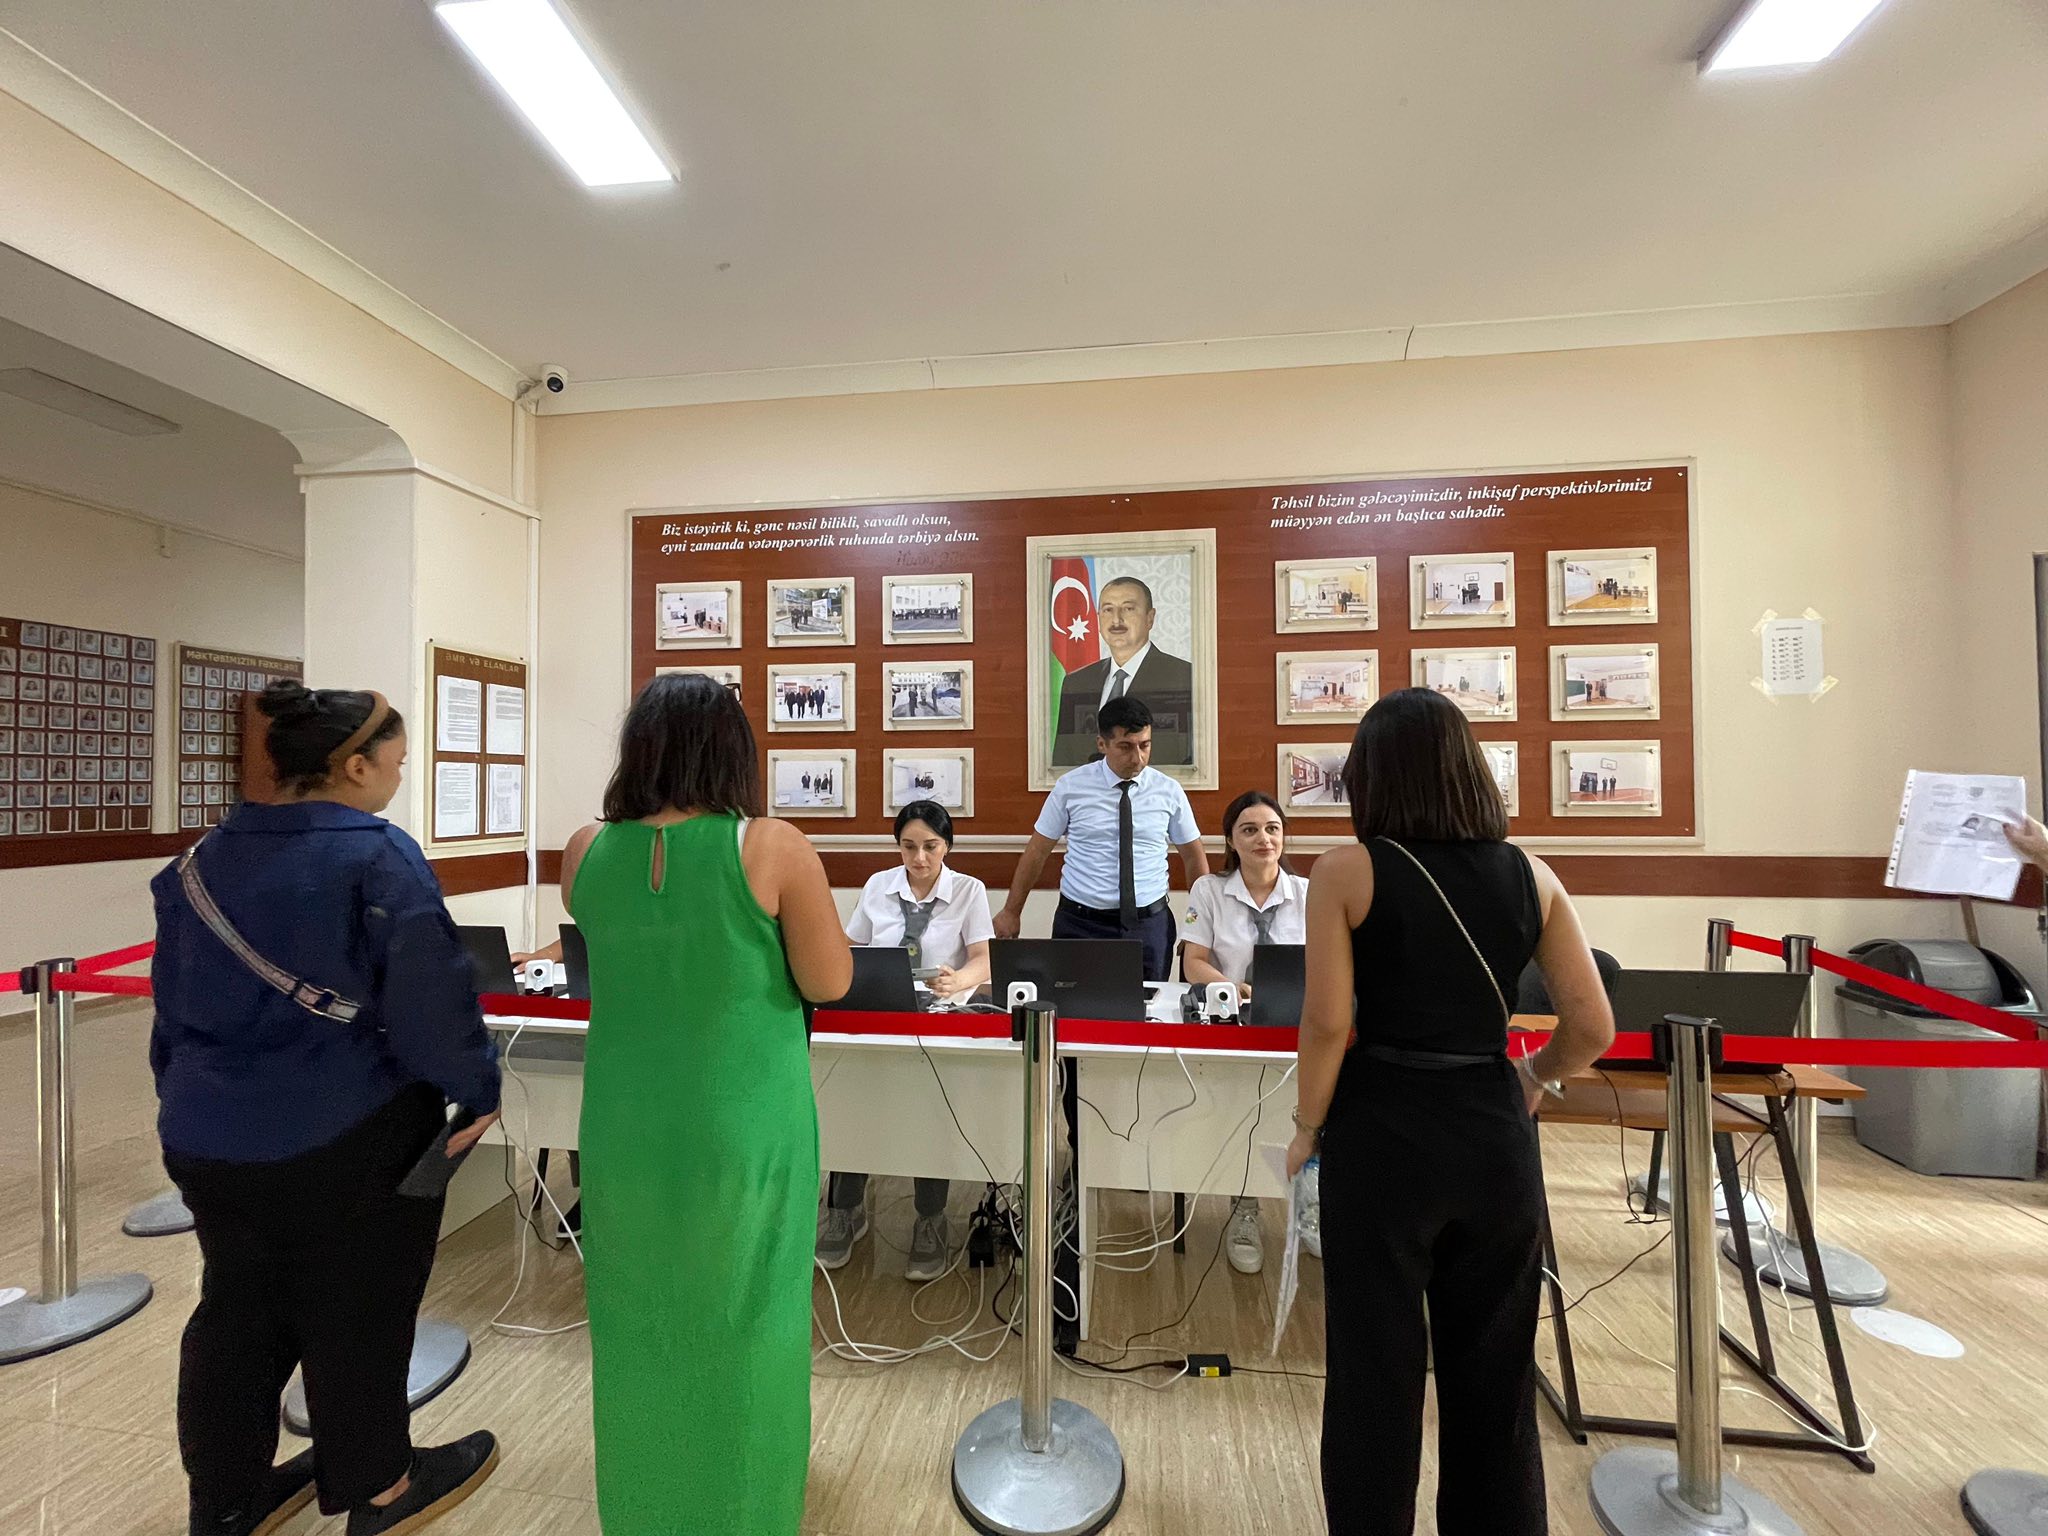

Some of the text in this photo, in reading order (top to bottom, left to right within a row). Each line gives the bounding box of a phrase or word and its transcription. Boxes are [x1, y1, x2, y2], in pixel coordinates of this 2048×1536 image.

[1271, 477, 1653, 510] Təhsil bizim gələcəyimizdir, inkişaf perspektivlərimizi
[661, 513, 951, 537] Biz istəyirik ki, gənc nəsil bilikli, savadlı olsun,
[1270, 504, 1506, 530] müəyyən edən ən başlıca sahədir.
[661, 529, 979, 555] eyni zamanda vətənpərvərlik ruhunda tərbiyə alsın.
[483, 659, 520, 673] ELANLAR
